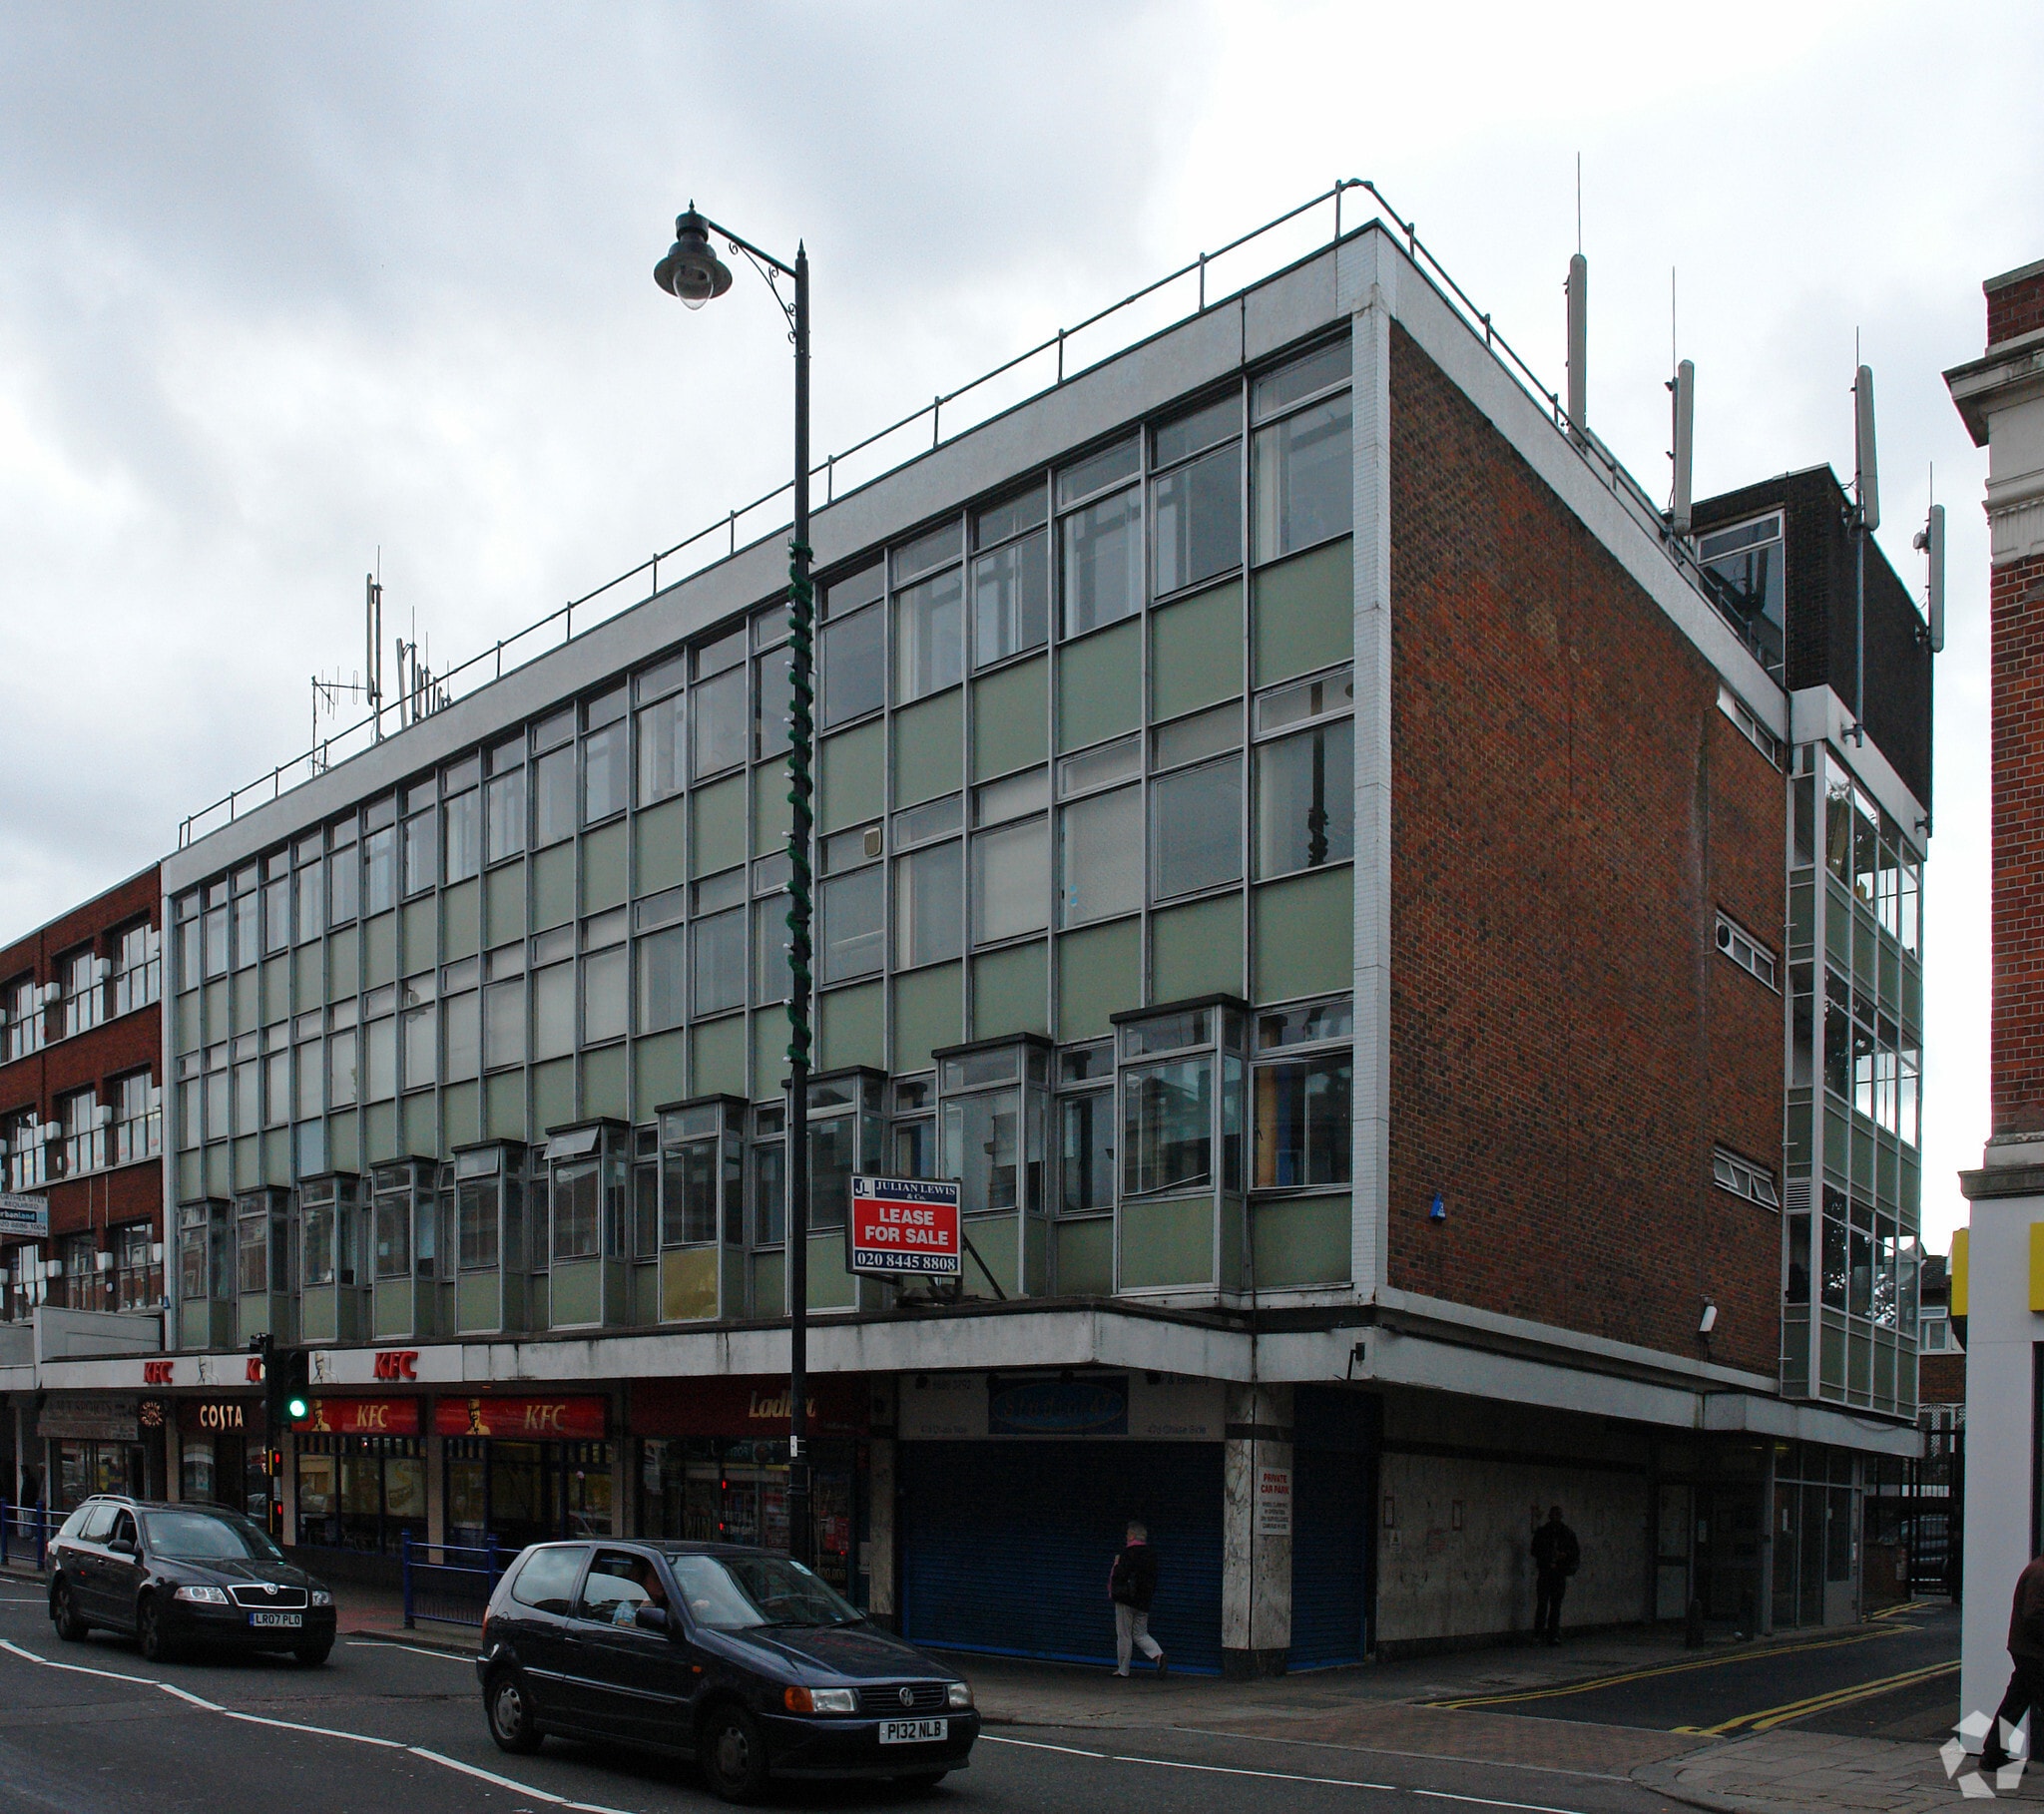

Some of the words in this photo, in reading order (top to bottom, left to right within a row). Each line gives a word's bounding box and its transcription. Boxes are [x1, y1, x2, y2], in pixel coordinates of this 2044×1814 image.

[876, 1181, 918, 1193] JULIAN
[920, 1184, 956, 1195] LEWIS
[879, 1207, 935, 1226] LEASE
[864, 1225, 900, 1242] FOR
[905, 1228, 949, 1246] SALE
[857, 1252, 883, 1266] 020
[886, 1254, 920, 1268] 8445
[922, 1256, 956, 1270] 8808
[144, 1361, 174, 1384] KFC
[372, 1351, 418, 1380] KFC
[200, 1404, 244, 1431] COSTA
[356, 1404, 389, 1428] KFC
[524, 1404, 567, 1431] KFC
[1264, 1473, 1287, 1484] PRIVATE
[1261, 1484, 1273, 1494] CAR
[1274, 1485, 1289, 1495] PARK
[256, 1613, 280, 1624] LR07
[887, 1722, 916, 1739] P132
[919, 1720, 941, 1738] NLB
